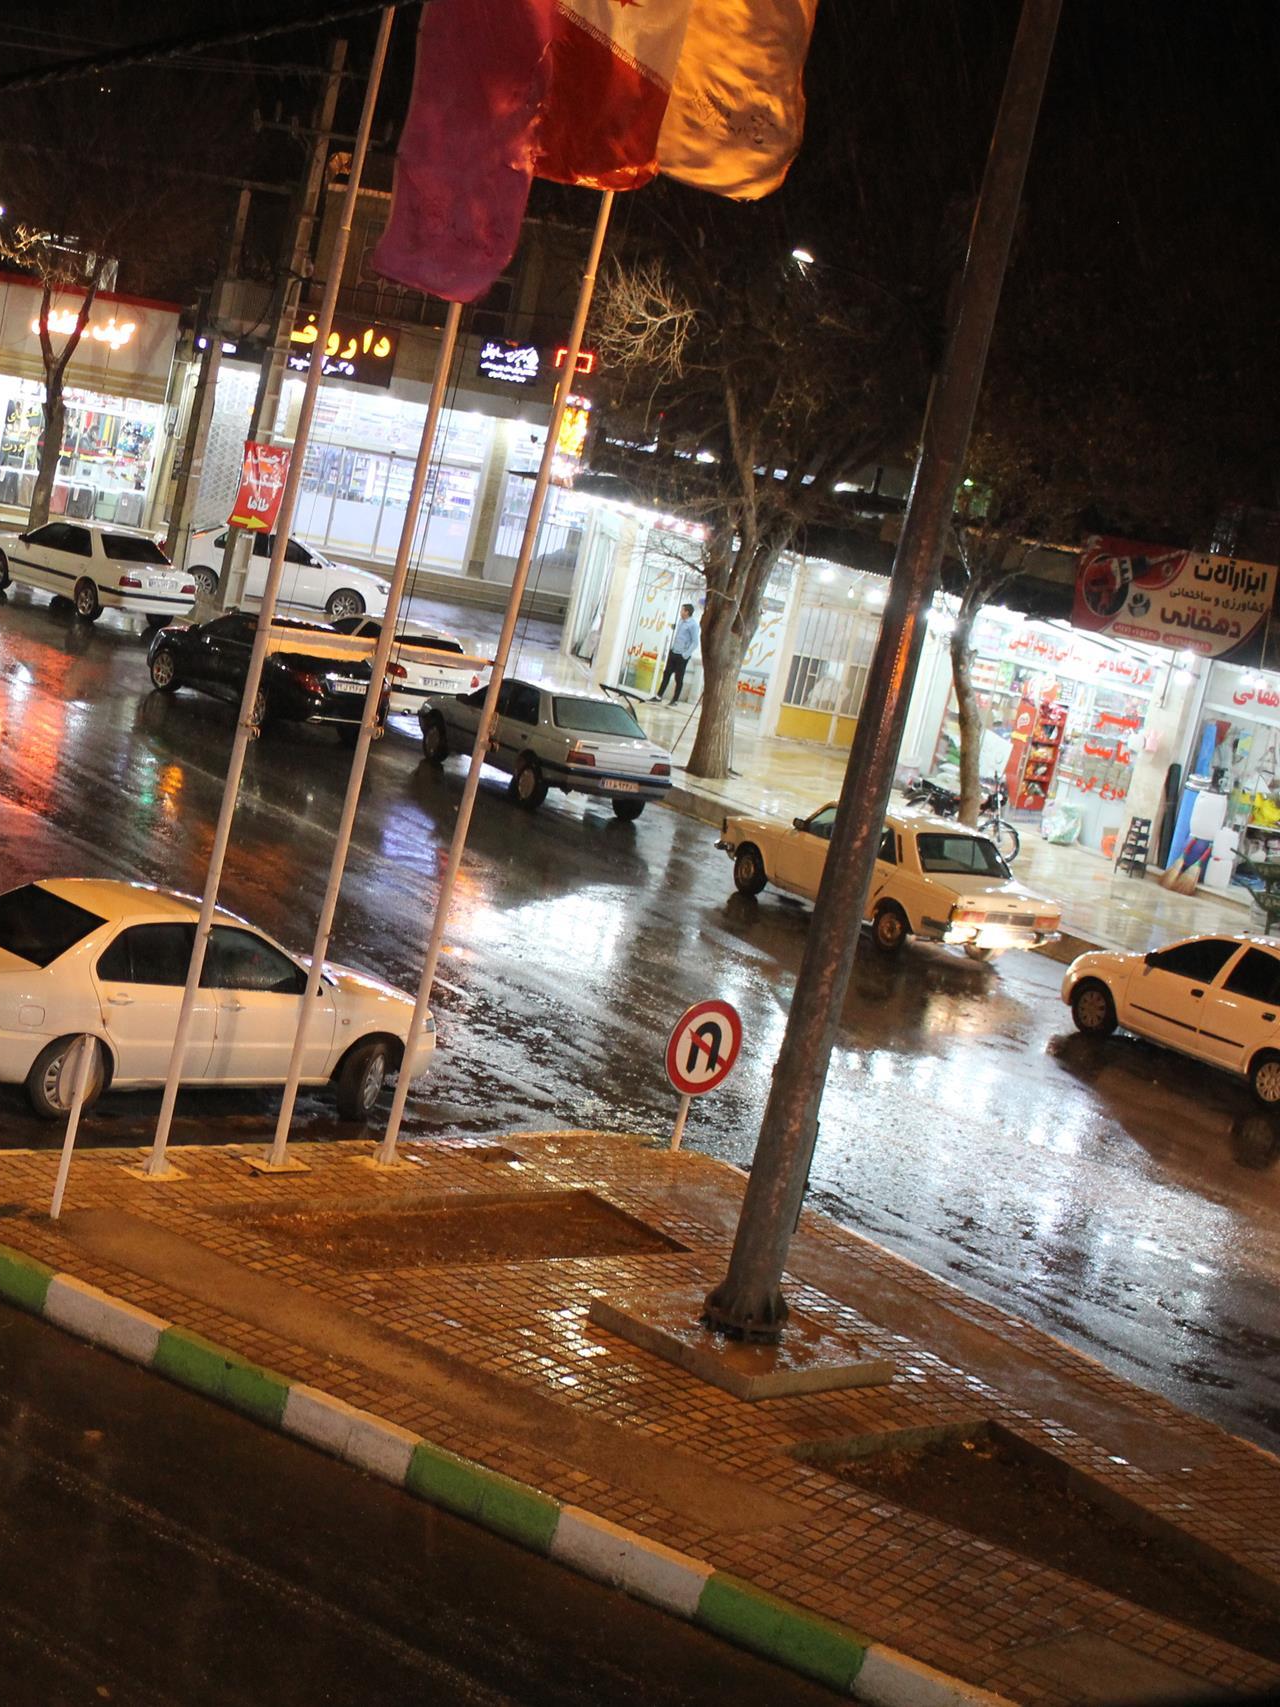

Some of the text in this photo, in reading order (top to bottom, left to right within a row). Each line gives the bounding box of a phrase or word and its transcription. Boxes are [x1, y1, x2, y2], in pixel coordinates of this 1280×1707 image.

[290, 314, 391, 358] داروخ
[1170, 587, 1213, 603] ساختمانی
[1221, 599, 1265, 614] کشاورزی
[1160, 606, 1242, 639] دهقانی
[1083, 738, 1131, 765] ماست
